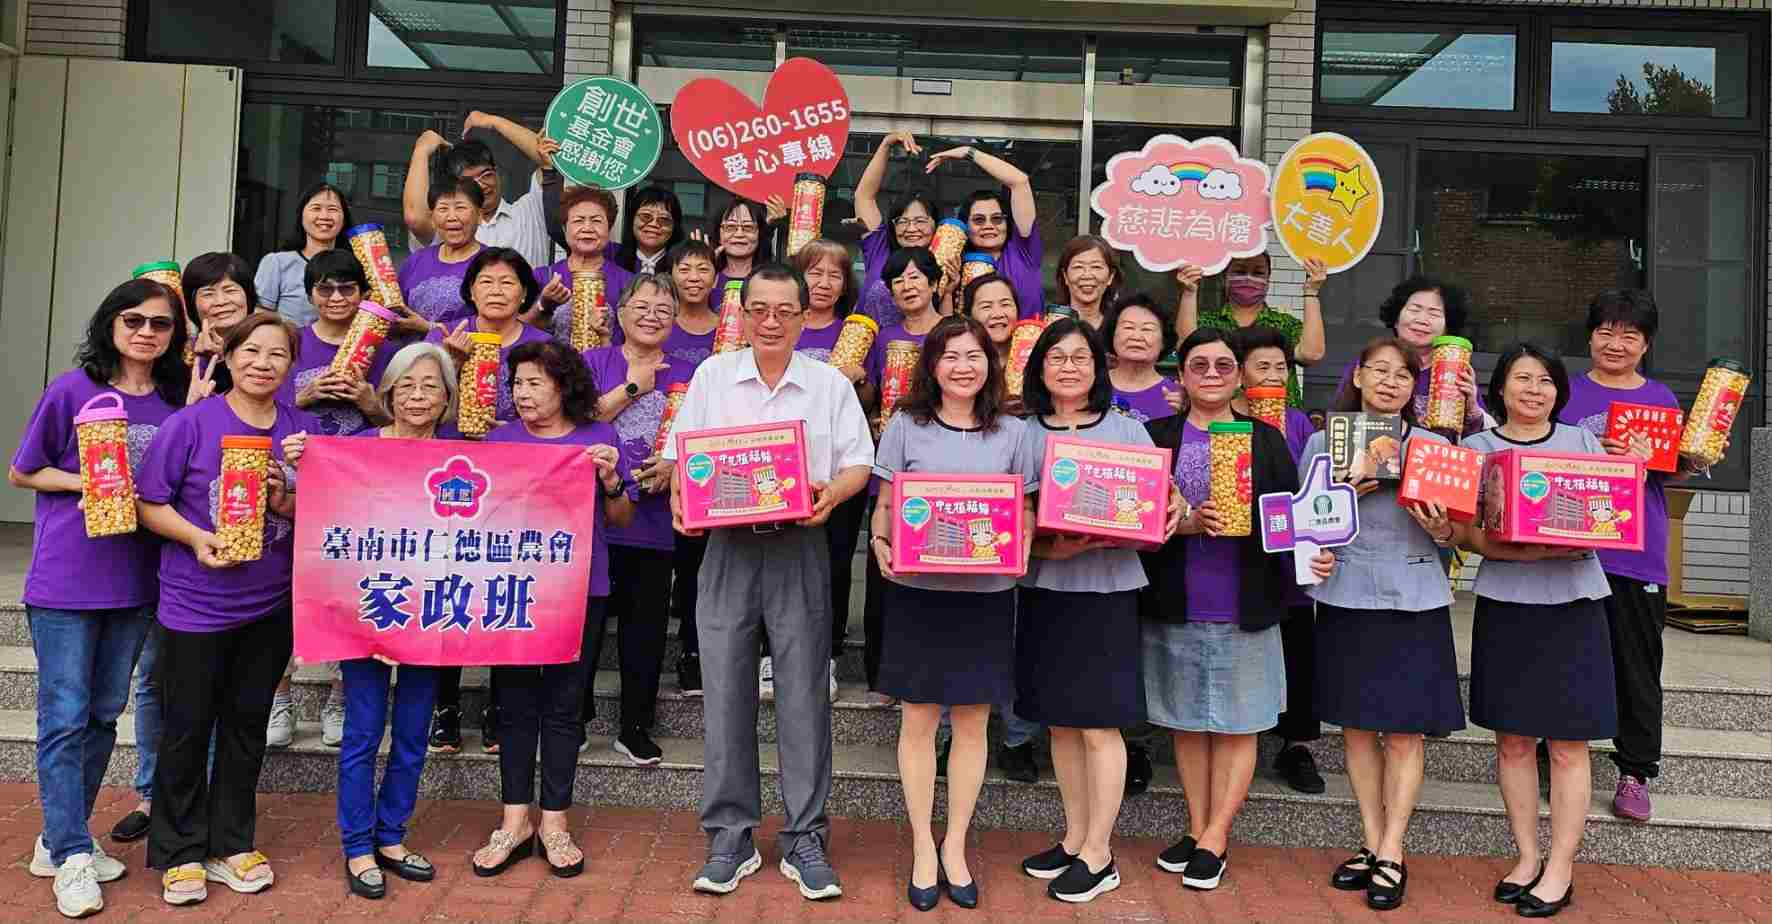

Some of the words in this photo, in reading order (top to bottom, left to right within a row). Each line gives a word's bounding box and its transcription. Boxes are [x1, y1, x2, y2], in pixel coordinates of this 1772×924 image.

[576, 85, 648, 138] 創世
[687, 100, 848, 159] (06)260-1655
[557, 138, 627, 183] 感謝您
[567, 115, 635, 161] 基金會
[722, 134, 836, 183] 愛心專線
[1117, 205, 1252, 245] 慈悲為懷
[1283, 200, 1354, 254] 大善人
[322, 527, 575, 564] 臺南市仁德區農會
[358, 572, 536, 633] 家政班
